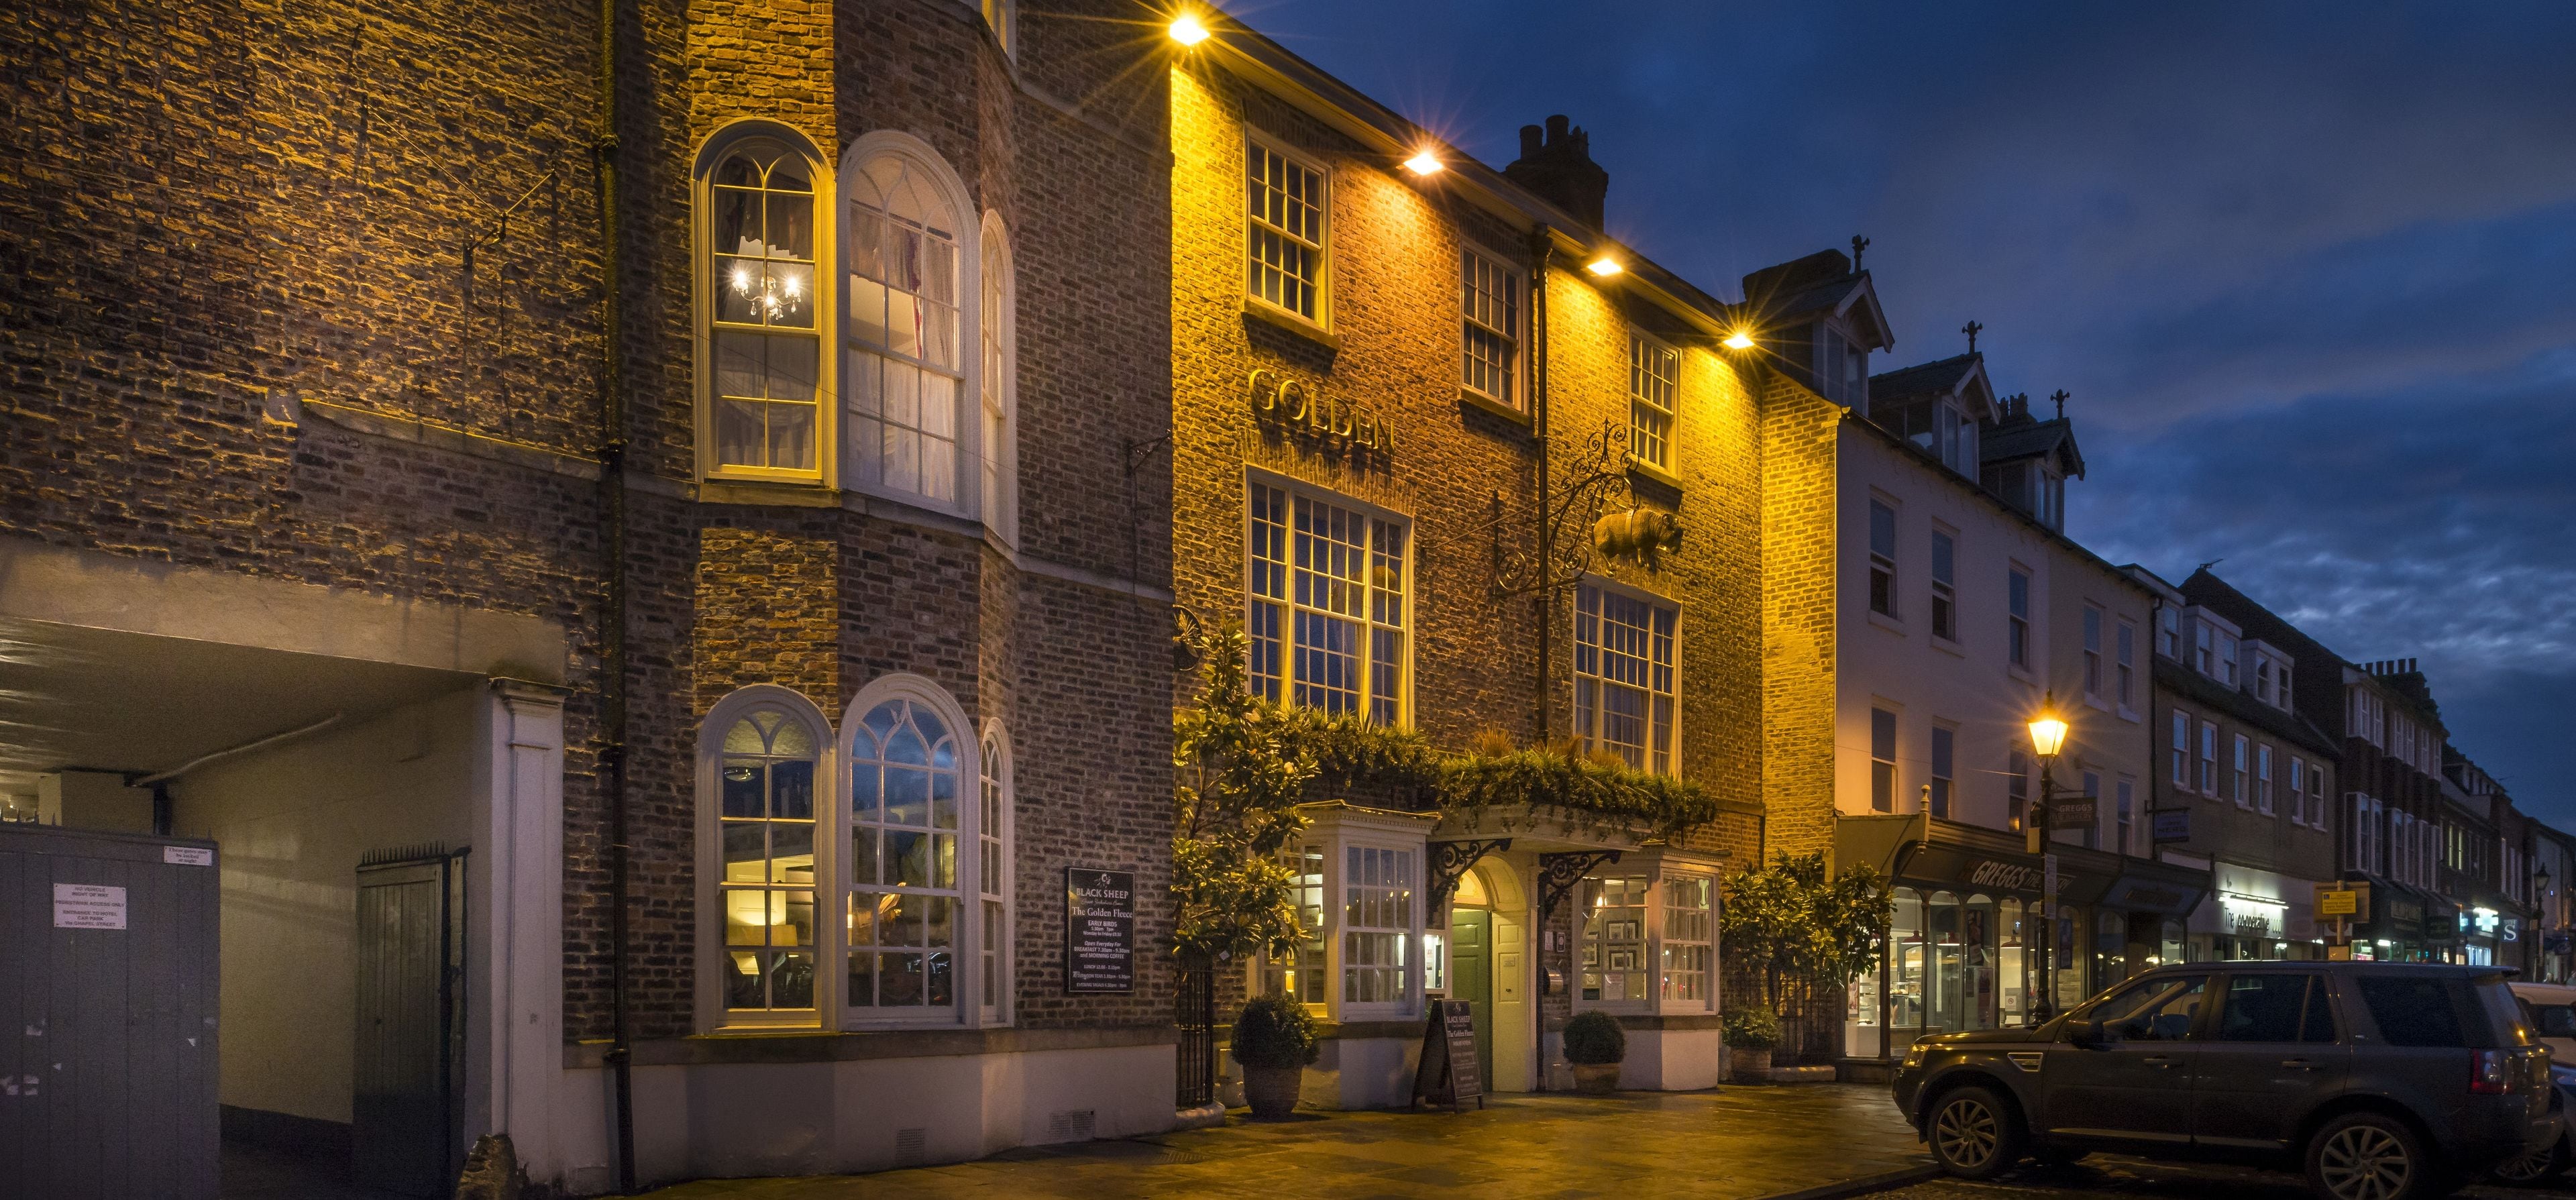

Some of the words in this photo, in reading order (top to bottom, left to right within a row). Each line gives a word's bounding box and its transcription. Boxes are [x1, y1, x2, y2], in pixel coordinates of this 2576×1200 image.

[1248, 369, 1395, 457] GOLDEN
[2059, 804, 2093, 812] GREGGS
[1971, 861, 2031, 889] GREGGS
[1076, 887, 1102, 897] BLACK
[1104, 889, 1128, 899] SHEEP
[1071, 906, 1085, 916] The
[1087, 908, 1112, 917] Golden
[1113, 909, 1133, 918] Fleece
[2224, 907, 2235, 929] The
[2504, 924, 2516, 940] S
